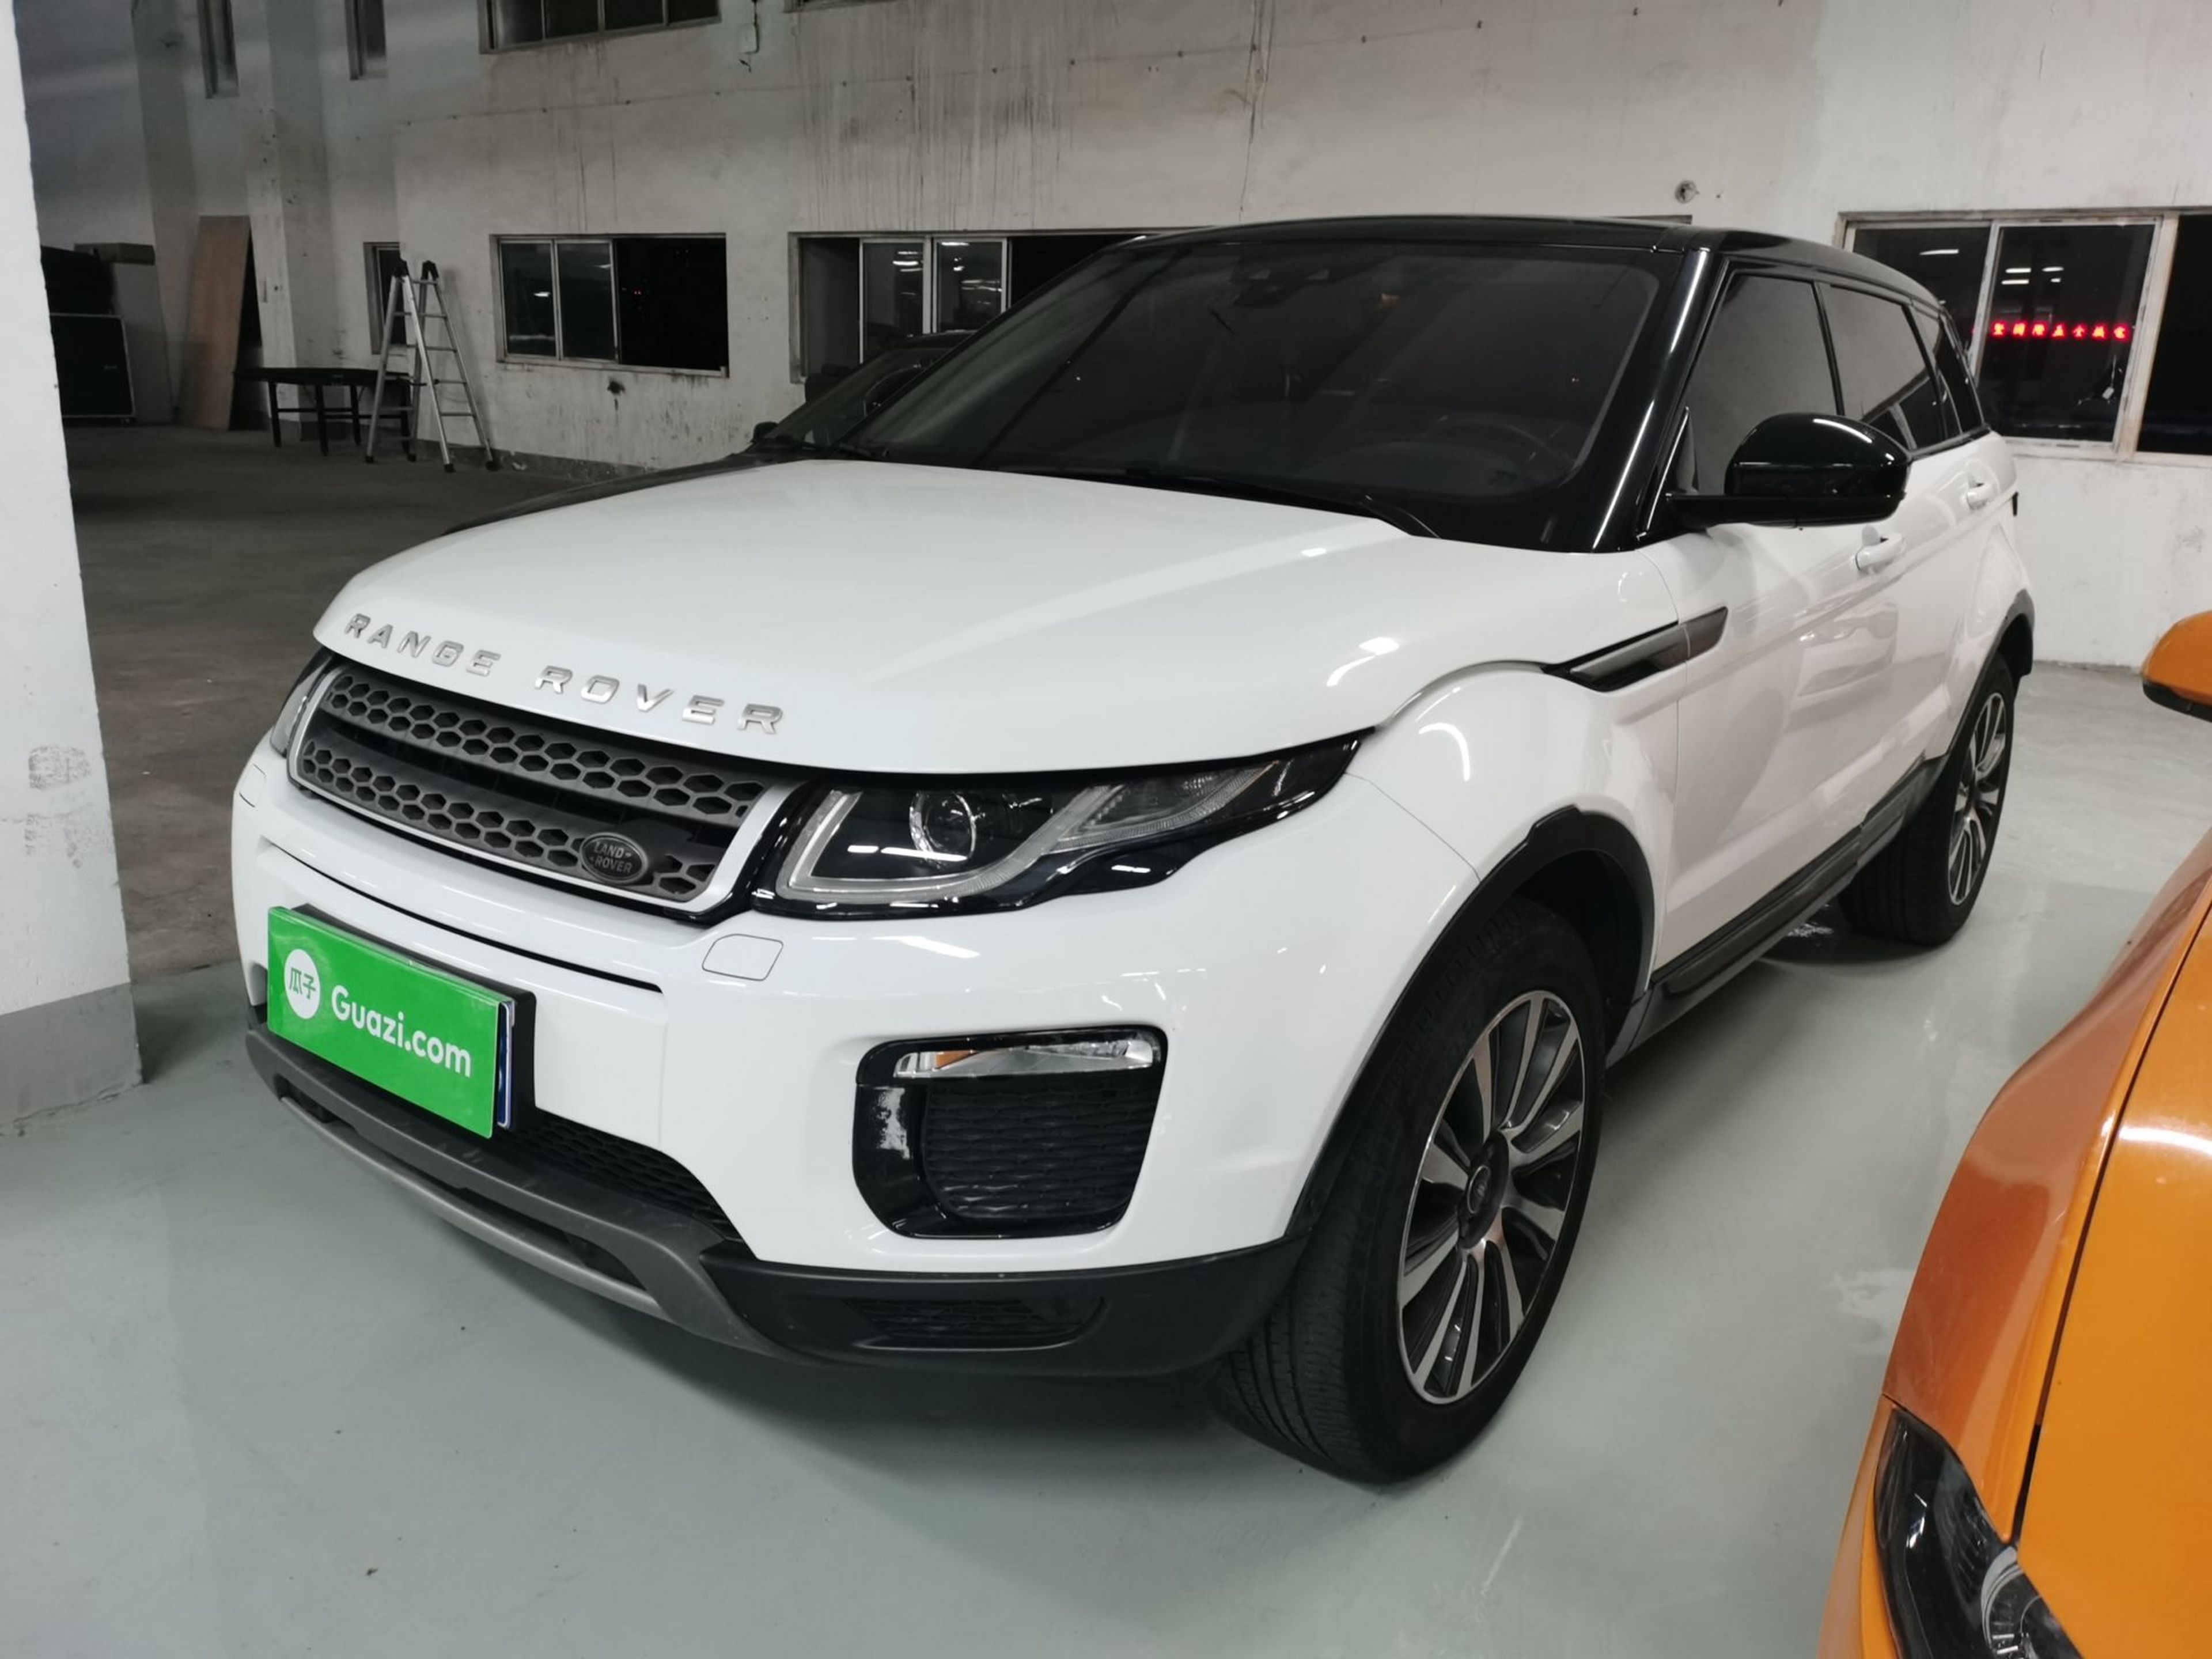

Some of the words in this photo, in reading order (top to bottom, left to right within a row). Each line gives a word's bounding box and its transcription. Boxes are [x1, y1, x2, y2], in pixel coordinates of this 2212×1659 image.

[344, 613, 501, 677] RANGE
[535, 665, 783, 734] ROVER
[594, 855, 632, 873] ROVER
[289, 967, 316, 1000] 瓜子
[331, 984, 471, 1078] Guazi.com
